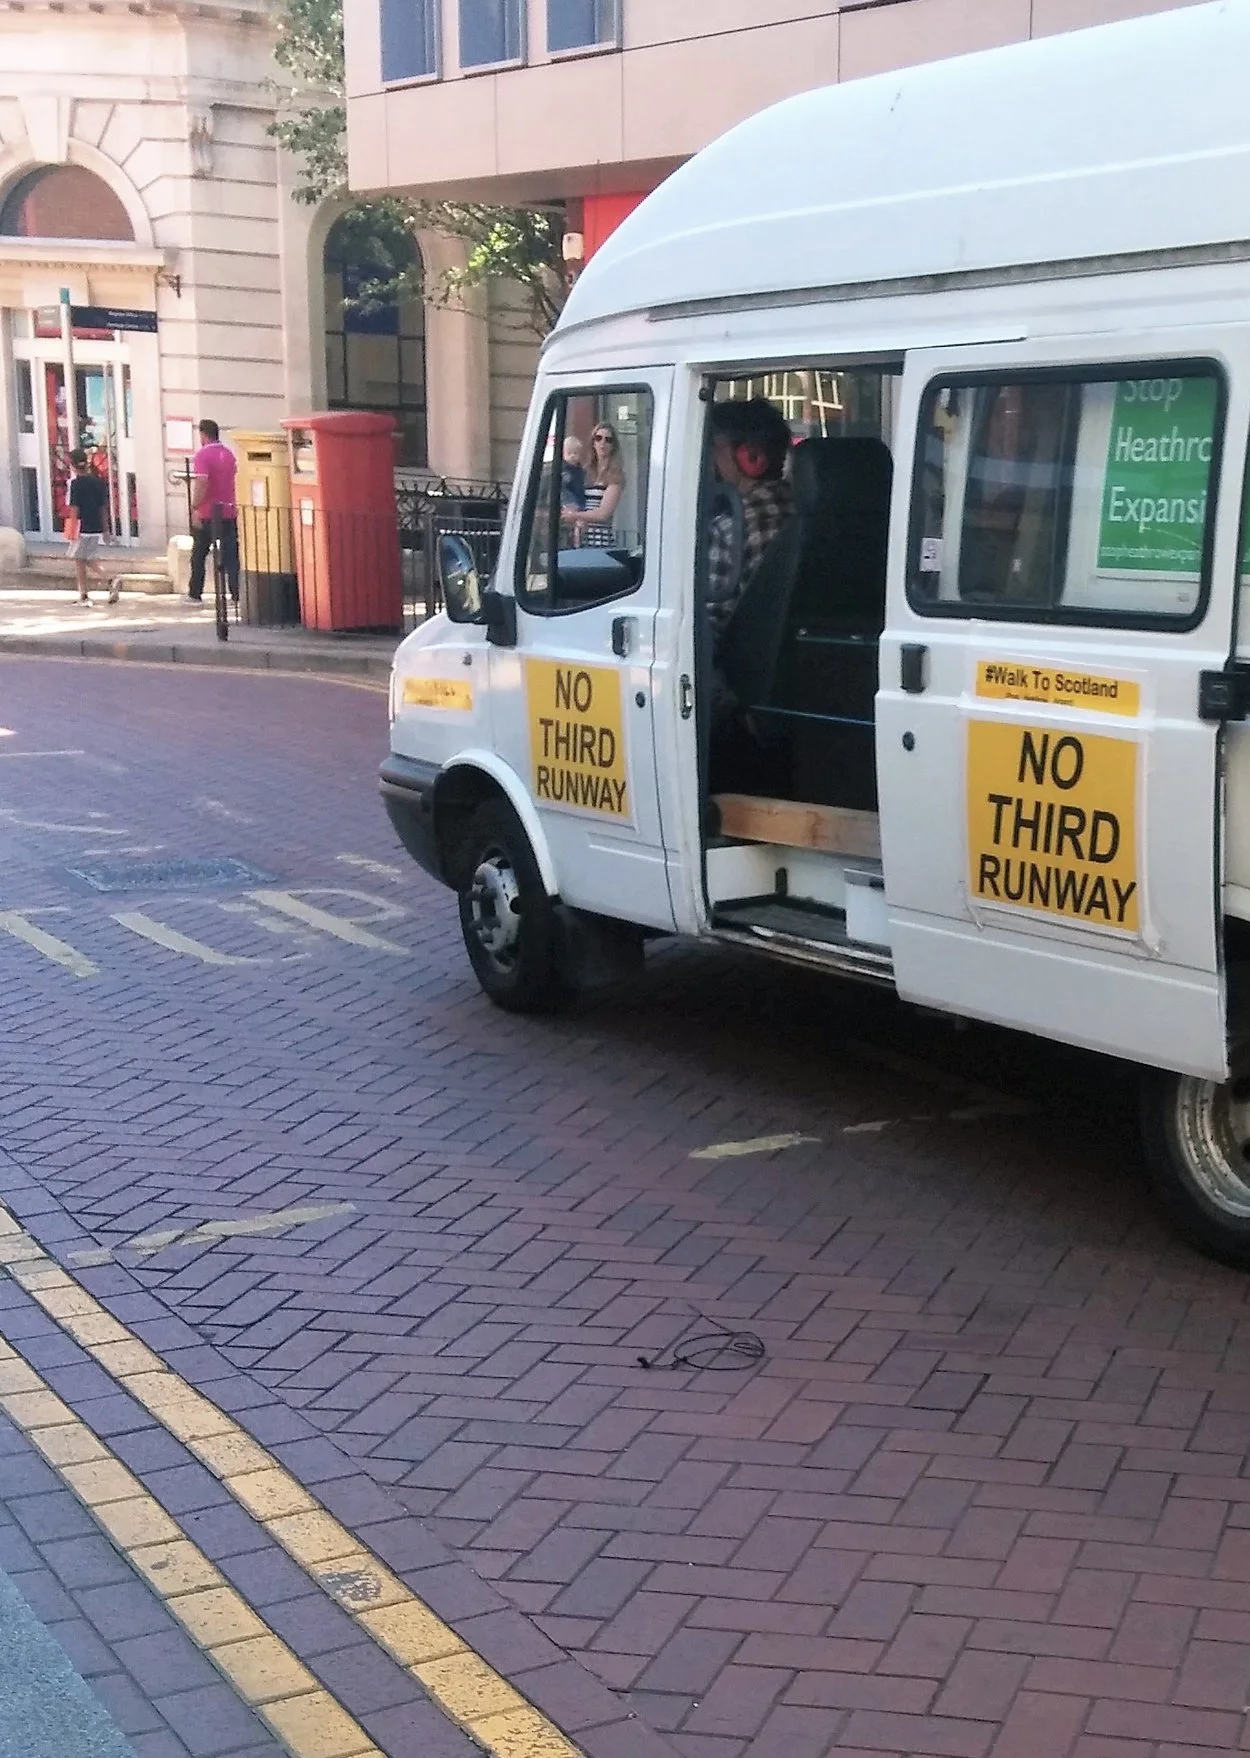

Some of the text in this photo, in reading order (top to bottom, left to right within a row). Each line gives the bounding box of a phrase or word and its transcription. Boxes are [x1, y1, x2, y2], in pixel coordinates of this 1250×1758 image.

[555, 669, 593, 712] NO
[985, 665, 1118, 699] #Walk To Scotland
[539, 718, 616, 768] THIRD
[1018, 731, 1084, 790] NO
[537, 765, 626, 812] RUNWAY
[988, 793, 1120, 864] THIRD
[978, 853, 1137, 922] RUNWAY
